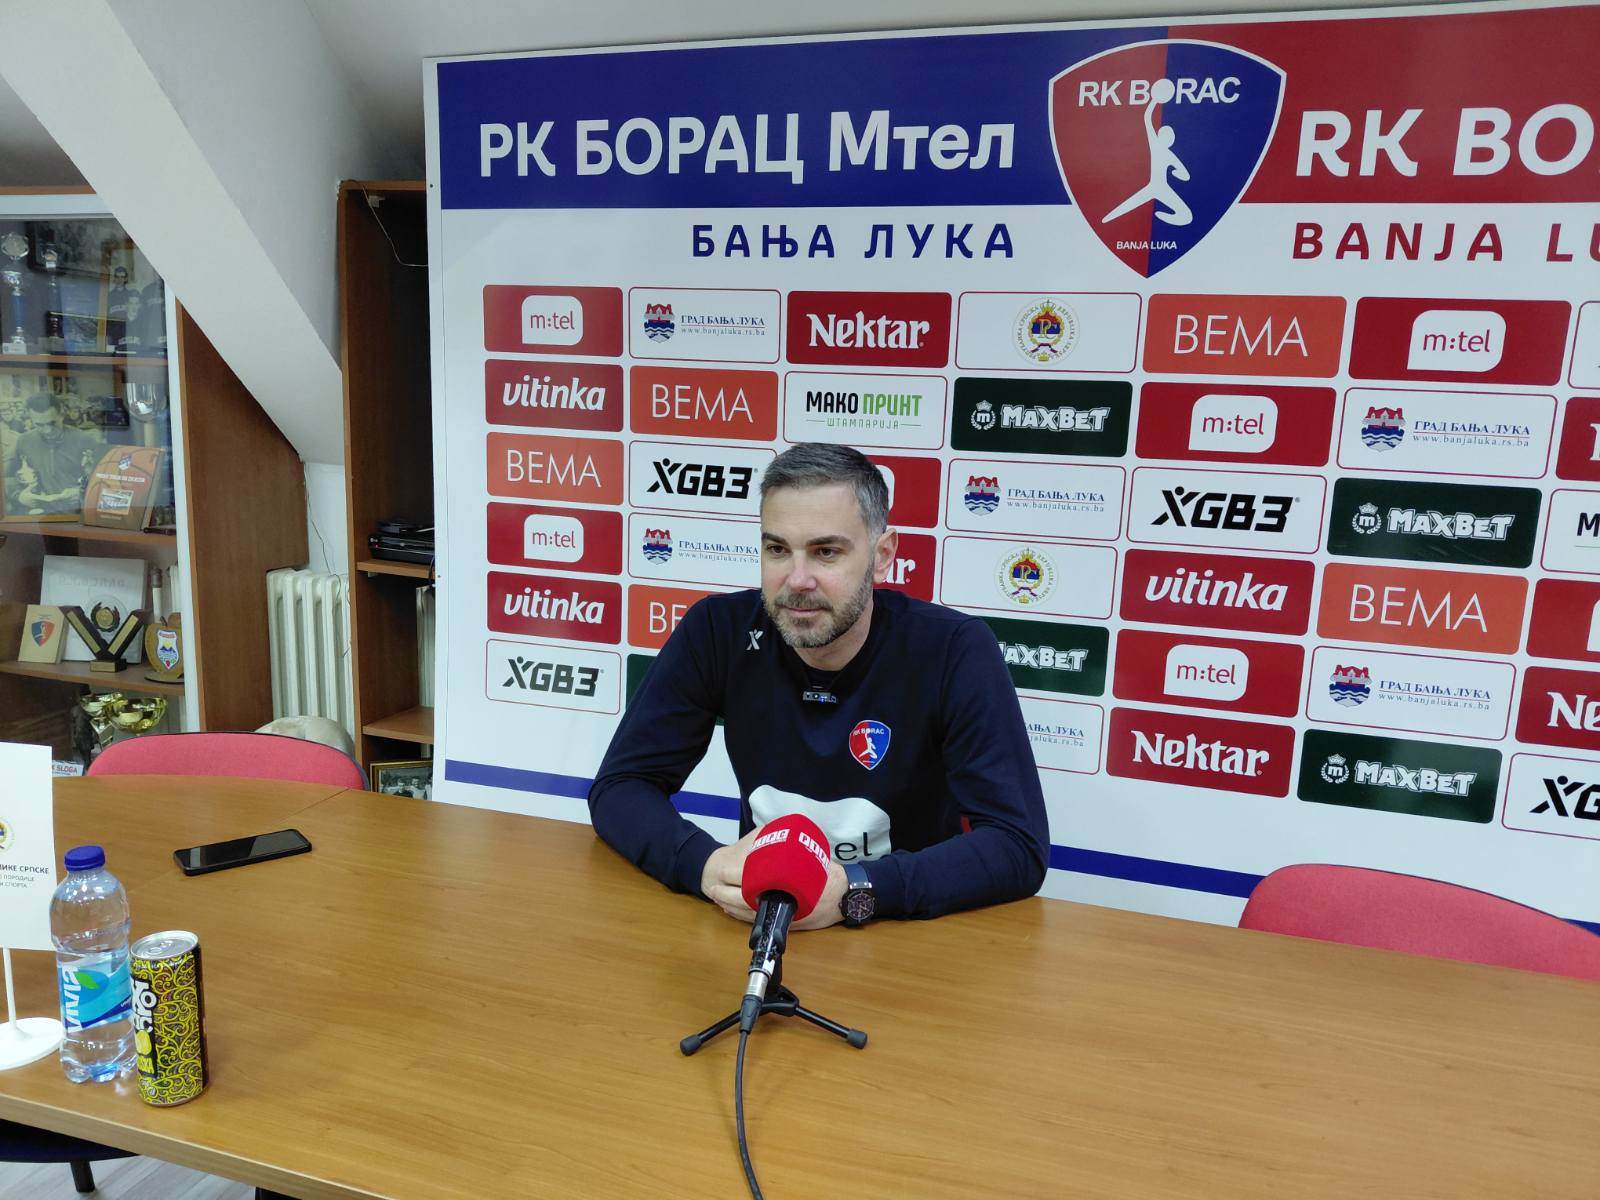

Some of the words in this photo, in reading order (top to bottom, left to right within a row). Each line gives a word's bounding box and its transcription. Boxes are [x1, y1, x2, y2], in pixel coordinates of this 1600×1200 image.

[1078, 80, 1123, 107] RK
[480, 121, 556, 177] РК
[576, 113, 804, 185] БОРАЦ
[829, 110, 1014, 172] Мтел
[1295, 109, 1425, 178] RK
[1453, 103, 1600, 177] BO
[693, 224, 835, 259] БАЊА
[864, 223, 1014, 259] ЛУКА
[1116, 241, 1149, 250] BANJA
[1151, 240, 1177, 250] LUKA
[1292, 222, 1503, 262] BANJA
[530, 310, 575, 330] m:tel
[681, 315, 706, 326] ГРАД
[707, 315, 735, 326] БАЊА
[737, 317, 765, 326] ЛУКА
[807, 310, 930, 349] Nektar
[1173, 314, 1309, 358] BEMA
[1423, 329, 1490, 353] m:tel
[503, 374, 606, 411] vitinka
[652, 383, 754, 424] BEMA
[806, 391, 859, 414] МАКО
[863, 393, 923, 417] ПРИНТ
[1000, 403, 1111, 433] MAXBET
[1202, 413, 1264, 435] m:tel
[1414, 421, 1447, 432] ГРАД
[1451, 422, 1489, 433] БАЊА
[1492, 424, 1530, 435] ЛУКА
[506, 449, 602, 488] BEMA
[1008, 488, 1035, 498] ГРАД
[1038, 490, 1070, 500] БАЊА
[1072, 492, 1105, 501] ЛУКА
[532, 529, 576, 549] m:tel
[1387, 508, 1515, 541] MAXBET
[679, 541, 701, 550] ГРАД
[704, 543, 730, 552] БАЊА
[732, 545, 759, 554] ЛУКА
[1144, 568, 1289, 611] vitinka
[503, 588, 605, 625] vitinka
[1349, 583, 1488, 633] BEMA
[1177, 664, 1236, 685] m:tel
[1380, 680, 1410, 692] ГРАД
[1415, 683, 1451, 695] БАЊА
[1454, 687, 1491, 699] ЛУКА
[1025, 722, 1051, 733] АЊА
[1053, 726, 1084, 737] ЛУКА
[1131, 730, 1270, 777] Nektar
[1354, 759, 1477, 797] MAXBET
[20, 865, 49, 875] СРПСКЕ
